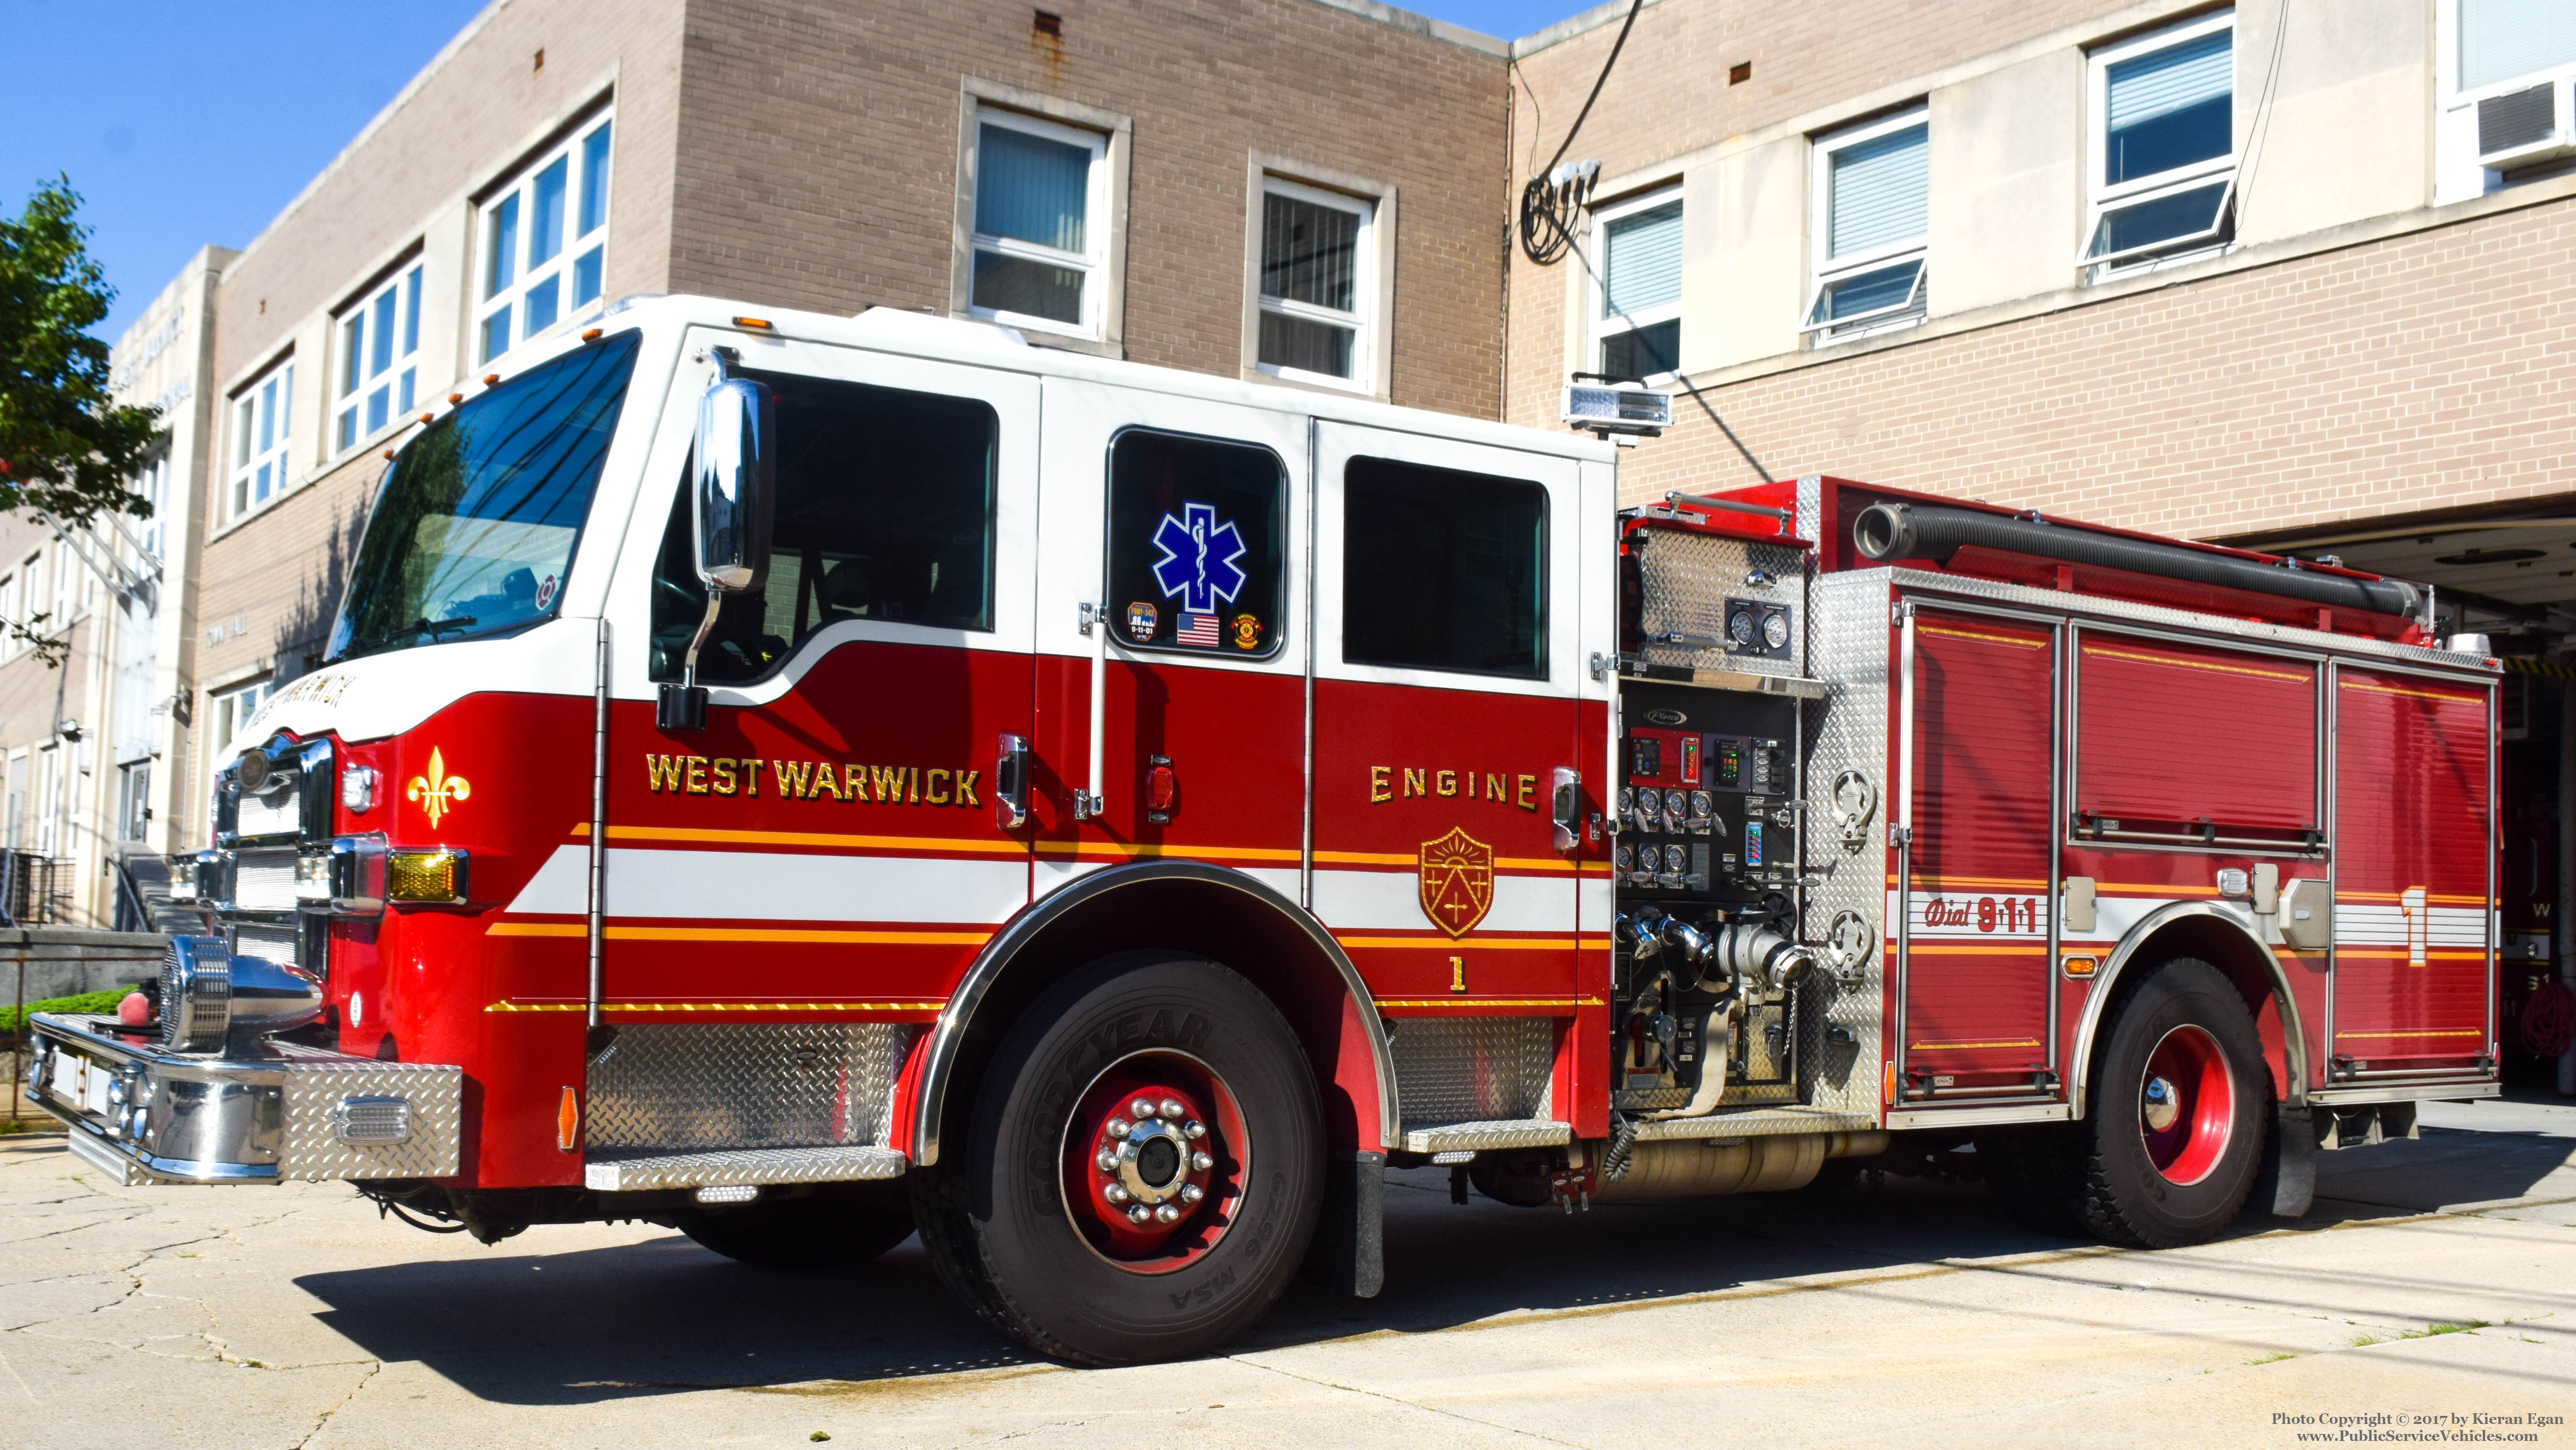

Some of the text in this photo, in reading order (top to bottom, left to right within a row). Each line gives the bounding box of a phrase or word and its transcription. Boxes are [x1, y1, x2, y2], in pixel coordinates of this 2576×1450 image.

[1131, 626, 1153, 634] 9-11-01
[646, 754, 980, 806] WEST WARWICK
[1371, 766, 1537, 810] ENGINE
[1925, 898, 1972, 927] Dial
[2399, 886, 2427, 967] 1
[1449, 956, 1466, 991] 1
[1027, 1009, 1212, 1218] GOODYEAR
